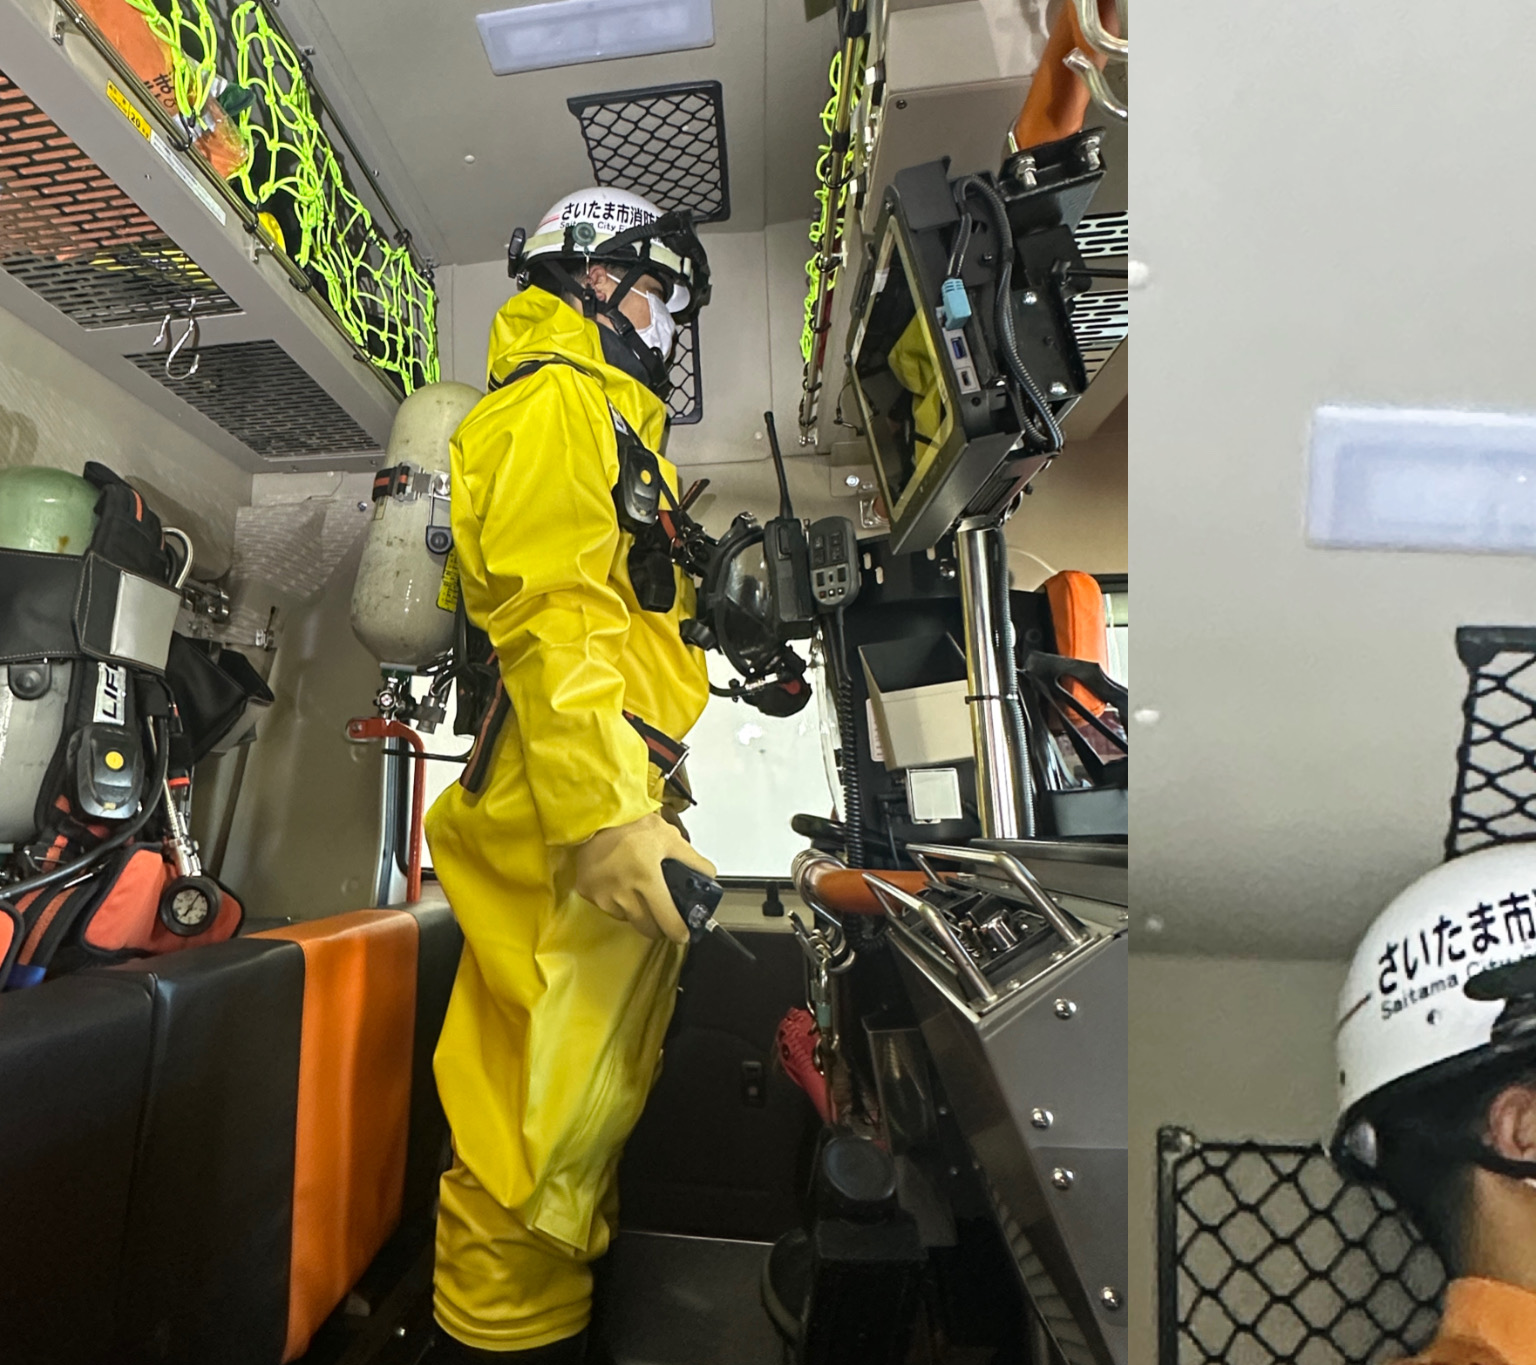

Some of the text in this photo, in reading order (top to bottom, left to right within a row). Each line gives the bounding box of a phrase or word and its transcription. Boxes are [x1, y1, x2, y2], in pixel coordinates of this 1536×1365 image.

[562, 201, 660, 226] さいたま市消防
[103, 663, 119, 719] LIF
[1381, 972, 1459, 1021] Saitama
